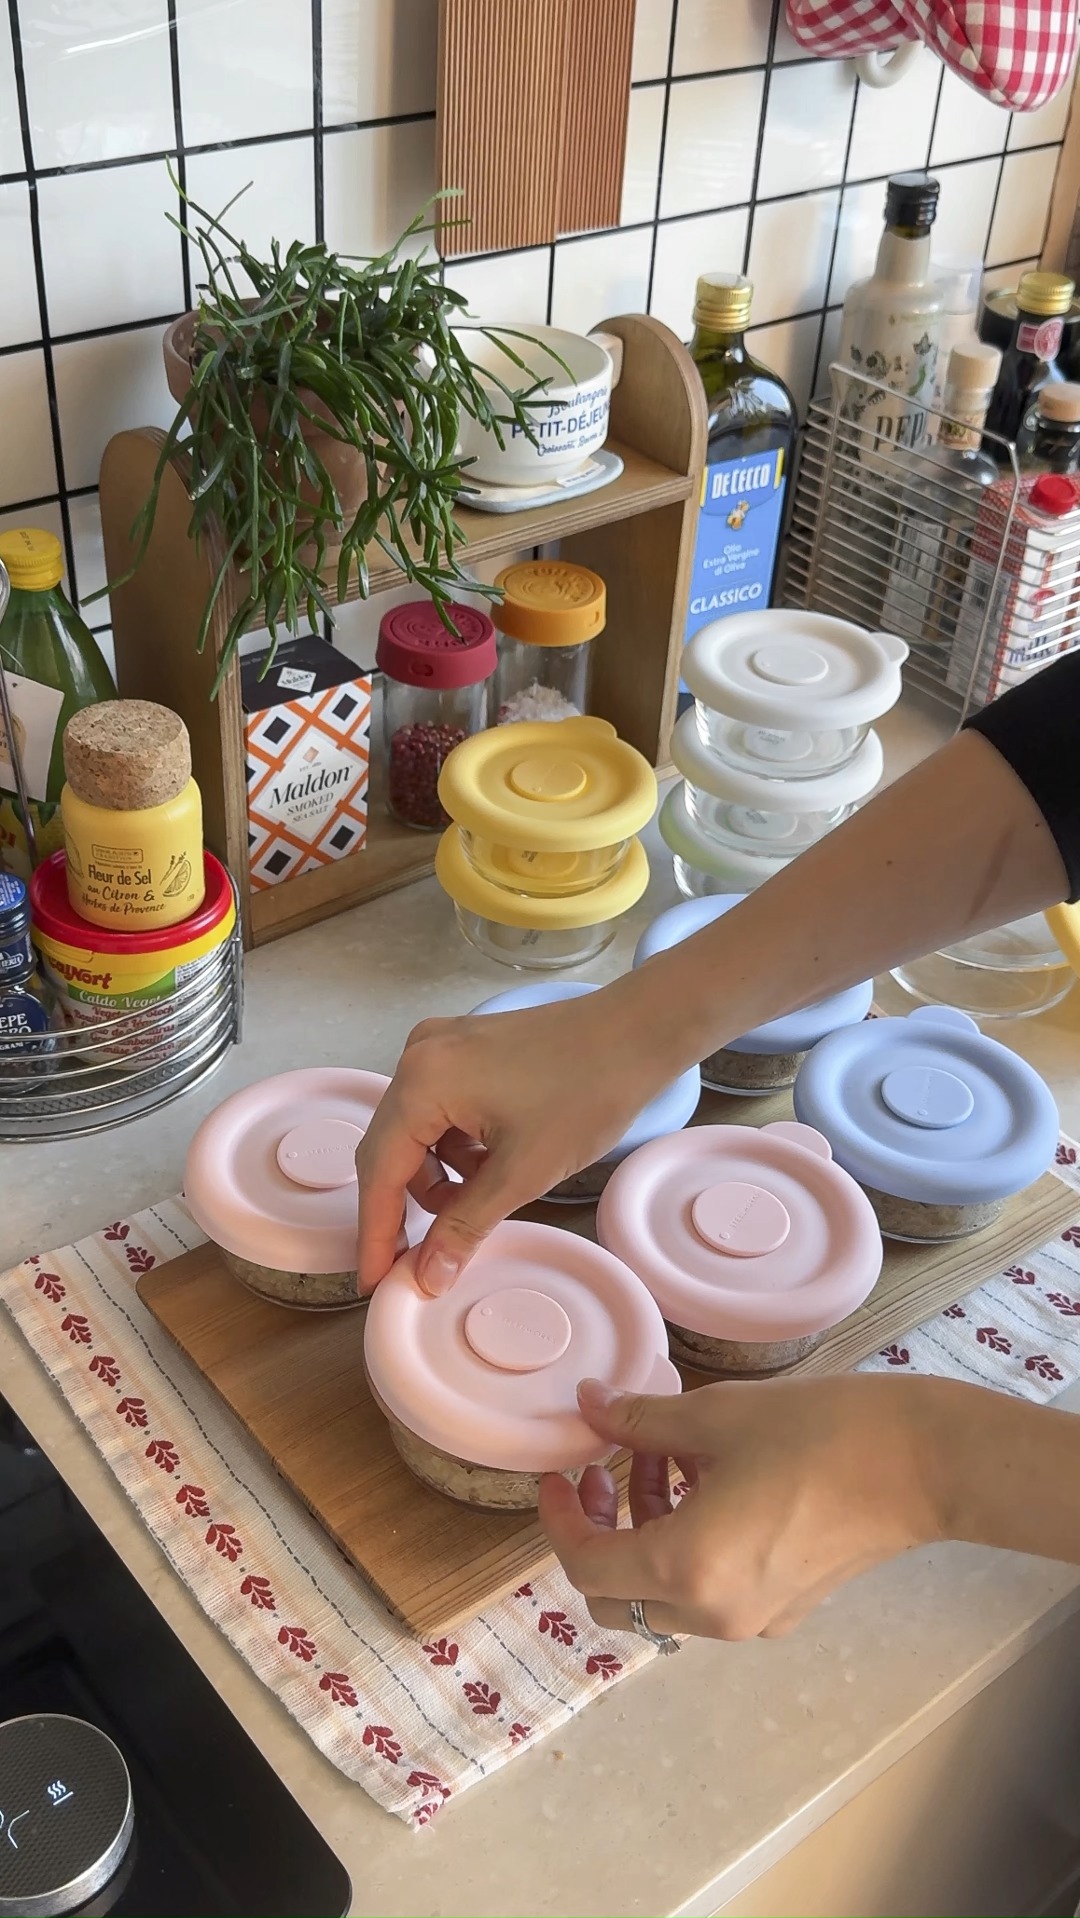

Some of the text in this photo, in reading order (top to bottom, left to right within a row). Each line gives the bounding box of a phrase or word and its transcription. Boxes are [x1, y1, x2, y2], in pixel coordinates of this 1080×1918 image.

[703, 547, 760, 569] Extra Vergine
[723, 544, 742, 555] Olio
[714, 561, 746, 576] di Oliva
[690, 582, 763, 614] CLASSICO
[269, 766, 350, 809] Maldon
[286, 792, 334, 816] SMOKED
[88, 864, 113, 883] Fleur
[117, 870, 132, 885] de
[134, 869, 152, 885] Sel
[102, 886, 139, 900] Citron
[143, 890, 155, 901] &
[110, 903, 120, 913] de
[124, 902, 165, 915] Provence
